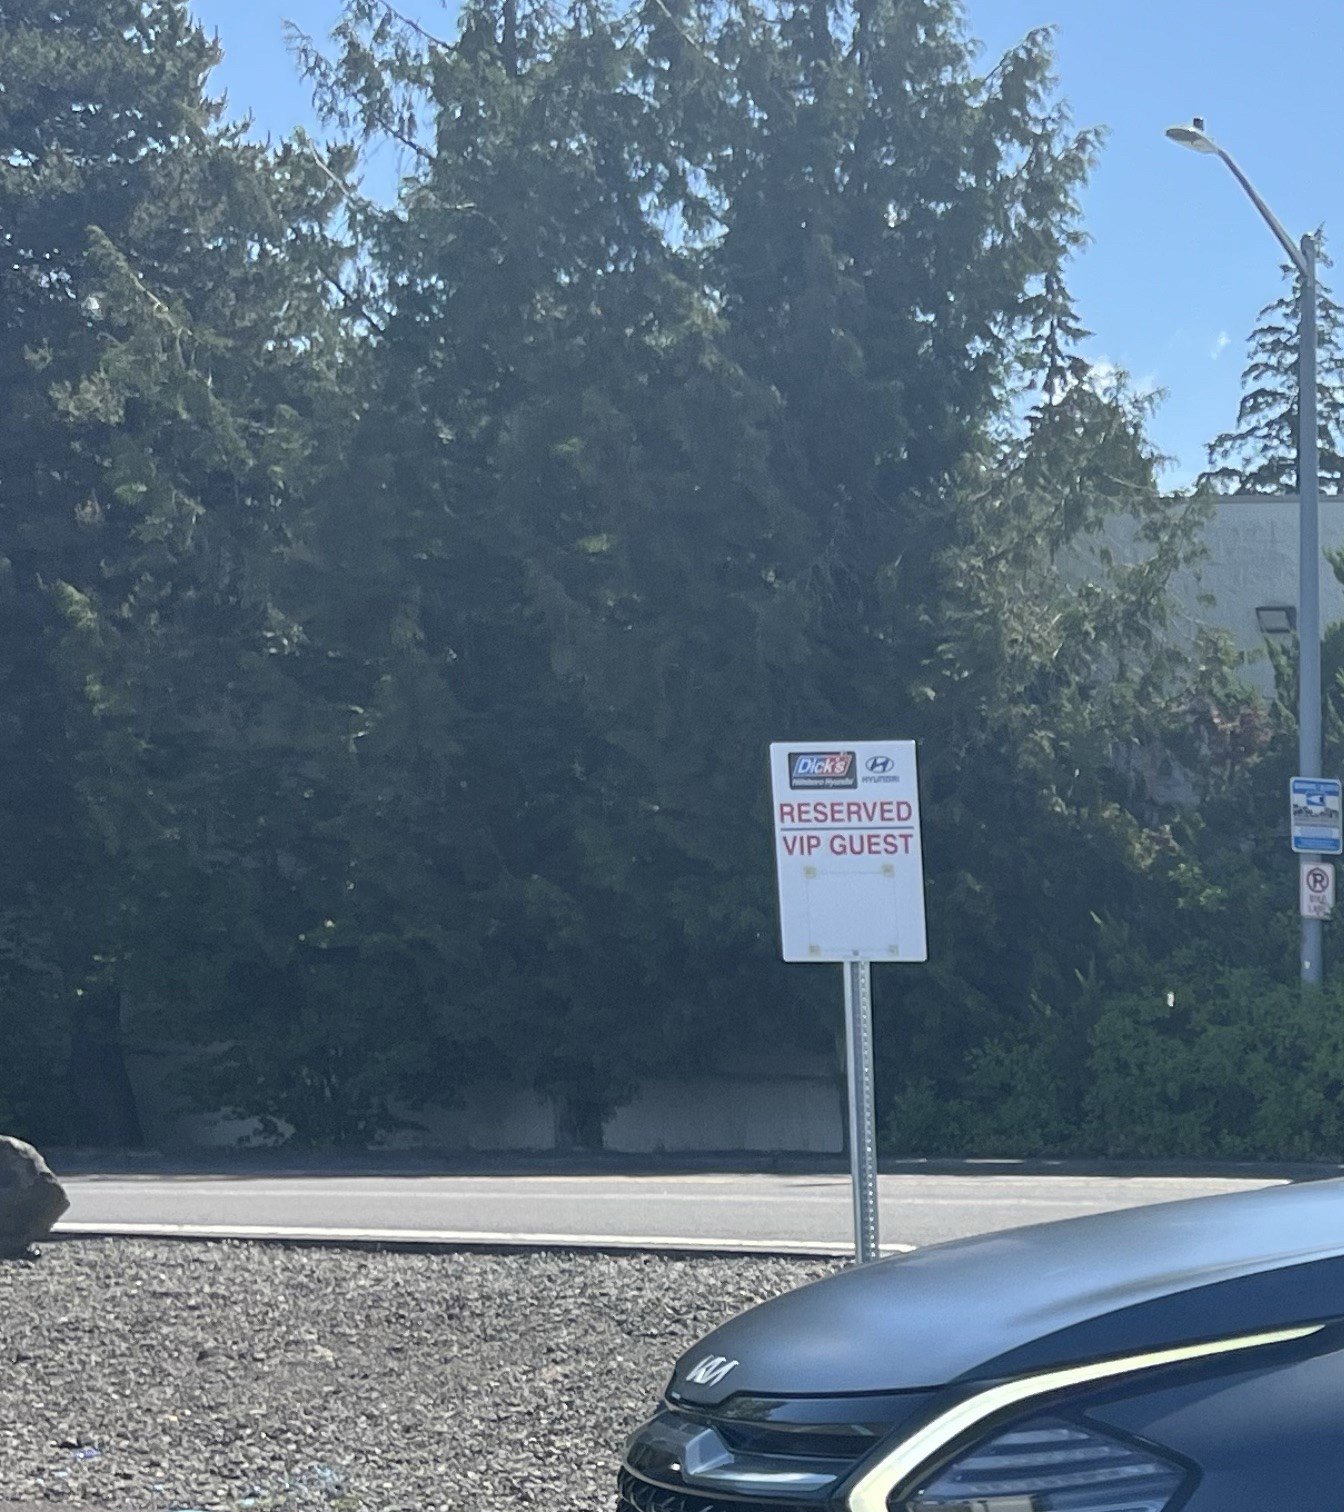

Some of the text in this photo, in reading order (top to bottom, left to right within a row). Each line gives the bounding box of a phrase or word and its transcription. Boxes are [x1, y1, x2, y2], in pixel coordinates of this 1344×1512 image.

[779, 801, 913, 824] RESERVED
[782, 834, 914, 856] VIP GUEST
